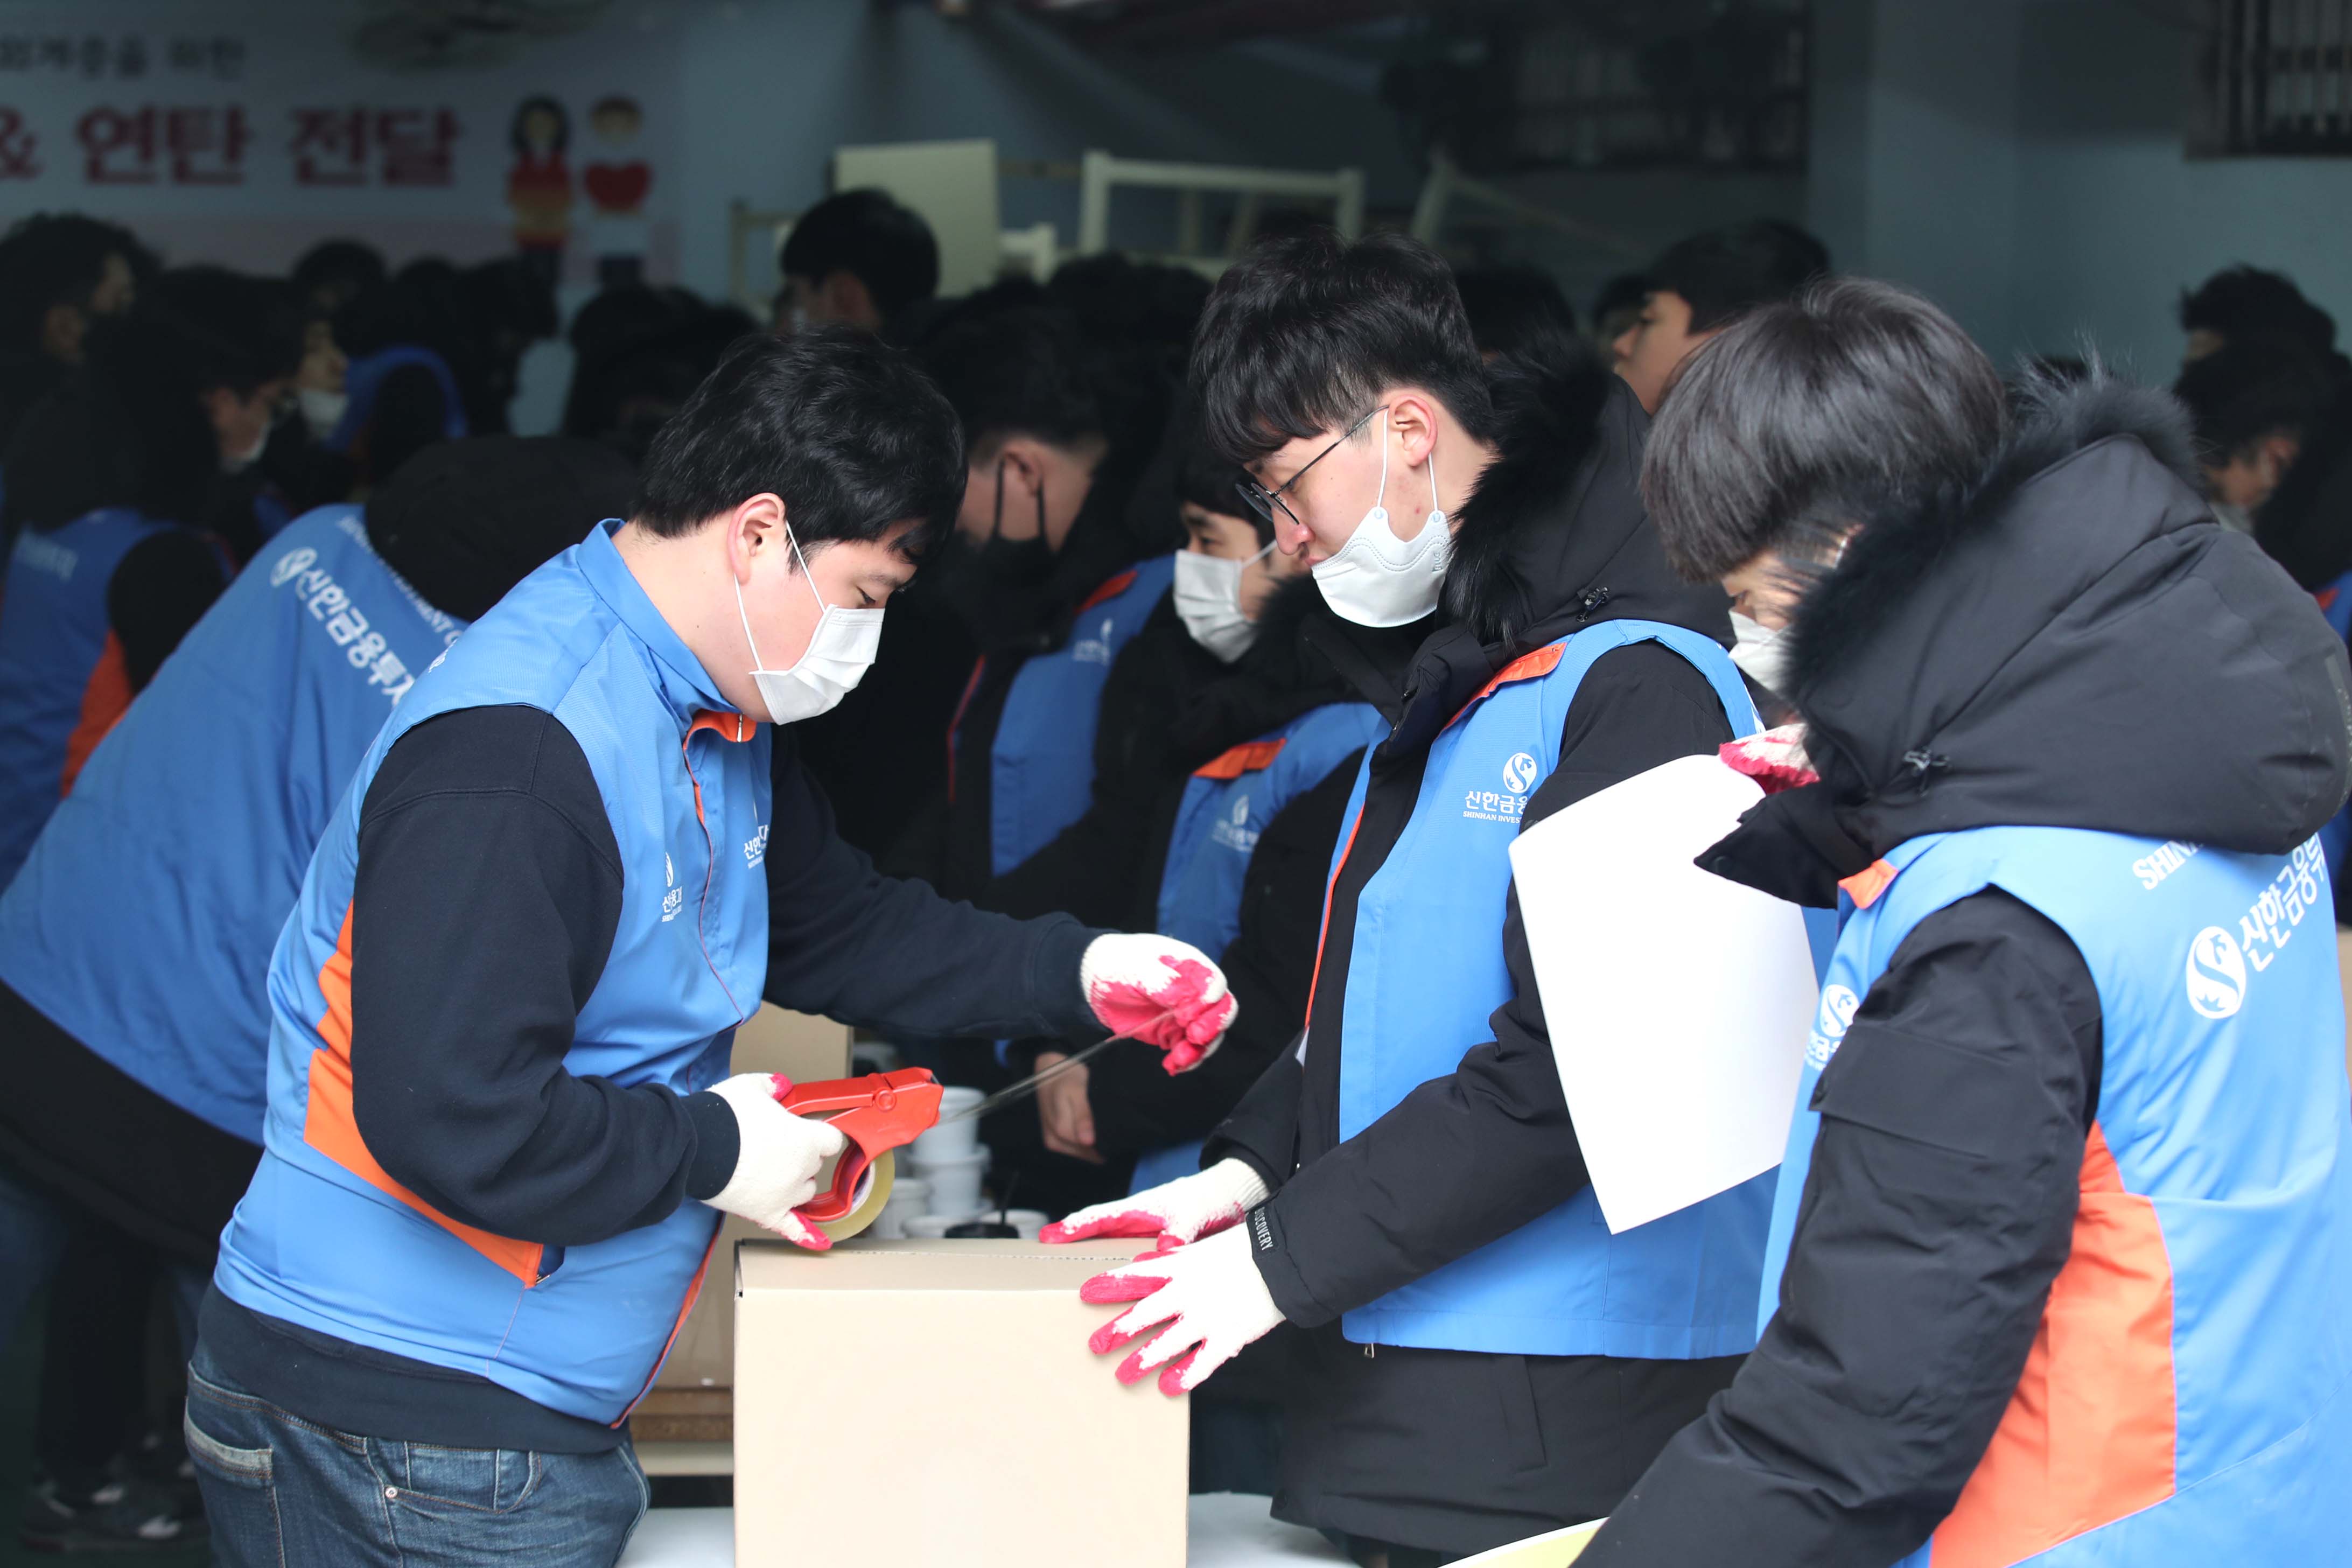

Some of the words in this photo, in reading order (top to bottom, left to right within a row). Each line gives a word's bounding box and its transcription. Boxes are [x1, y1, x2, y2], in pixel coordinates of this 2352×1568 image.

[75, 104, 255, 185] 연탄
[291, 107, 462, 186] 전달
[1462, 810, 1497, 821] SHINHAN
[1498, 815, 1522, 824] INVES
[1465, 790, 1528, 815] 신한금융
[2132, 839, 2203, 890] SHIN
[2239, 832, 2325, 972] 신한금융투
